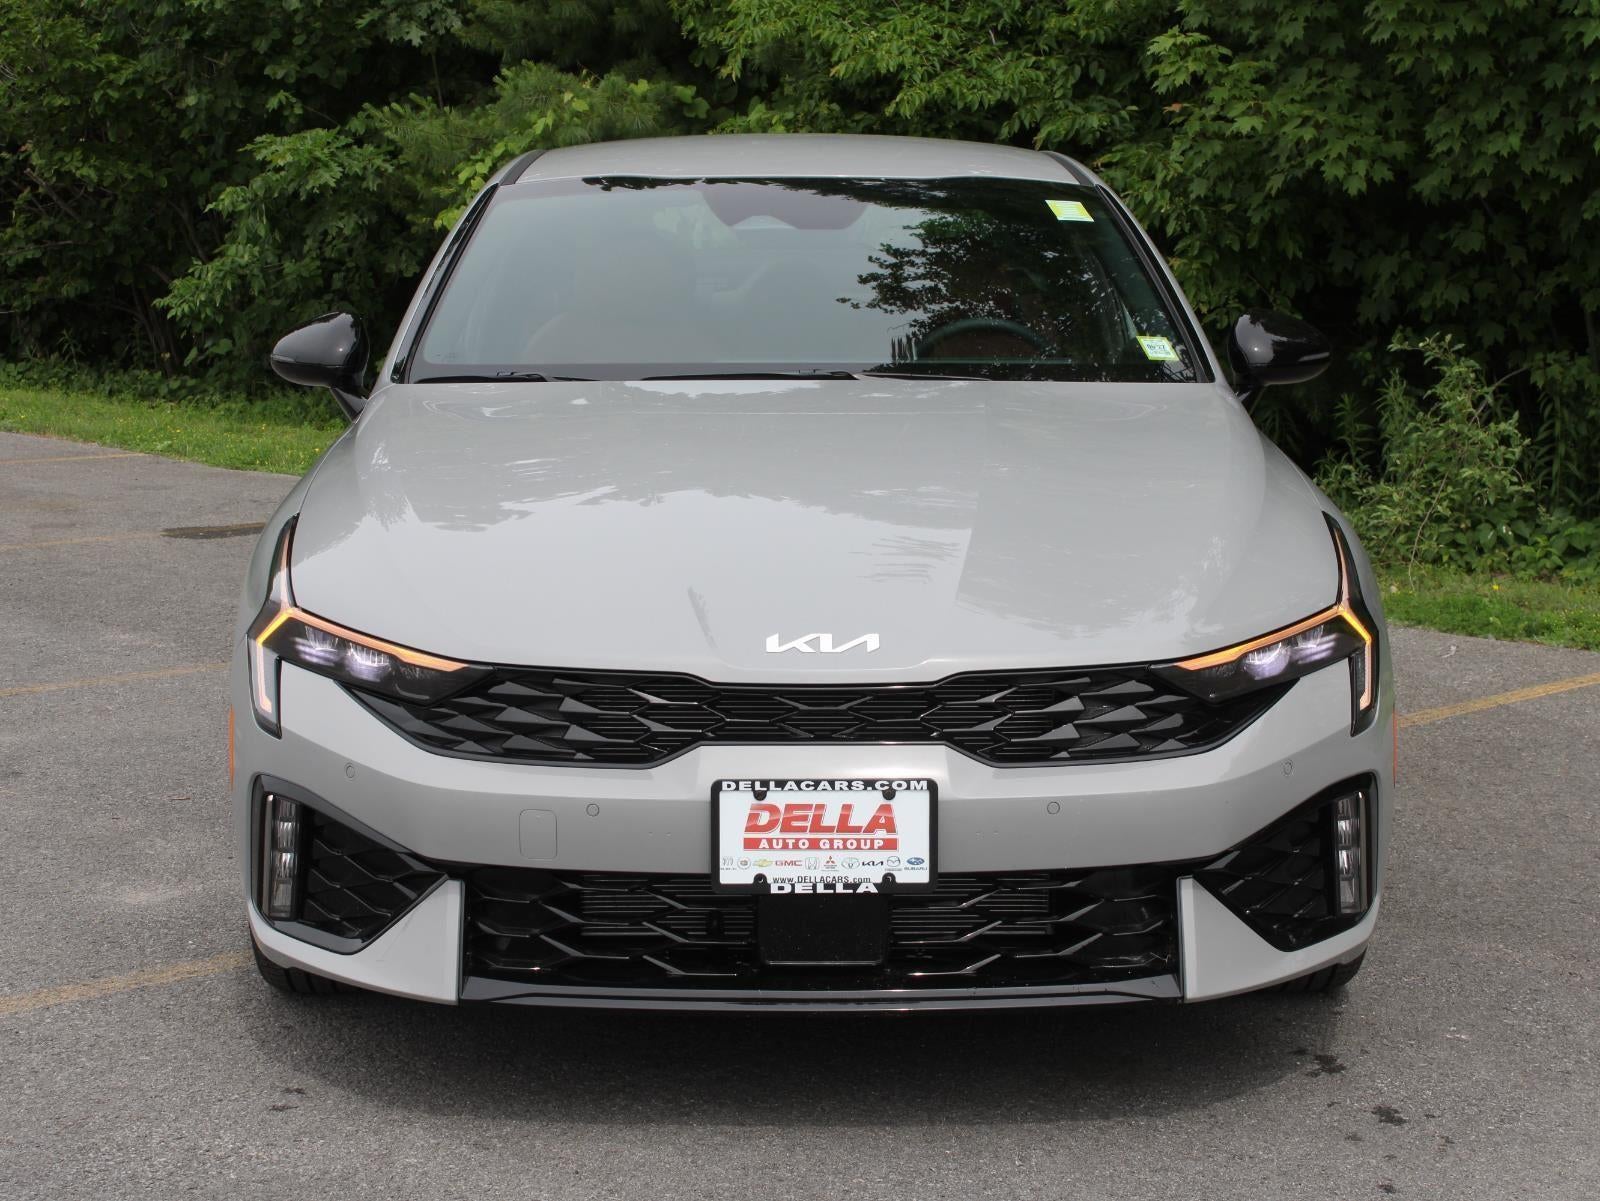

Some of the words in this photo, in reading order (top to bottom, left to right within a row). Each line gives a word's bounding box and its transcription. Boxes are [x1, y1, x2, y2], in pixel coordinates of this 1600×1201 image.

[721, 780, 928, 791] DELLACARS.COM
[744, 803, 897, 834] DELLA
[758, 838, 810, 849] AUTO
[819, 838, 884, 849] GROUP
[772, 875, 871, 883] www.DELLACARS.com
[770, 883, 879, 894] DELLA
